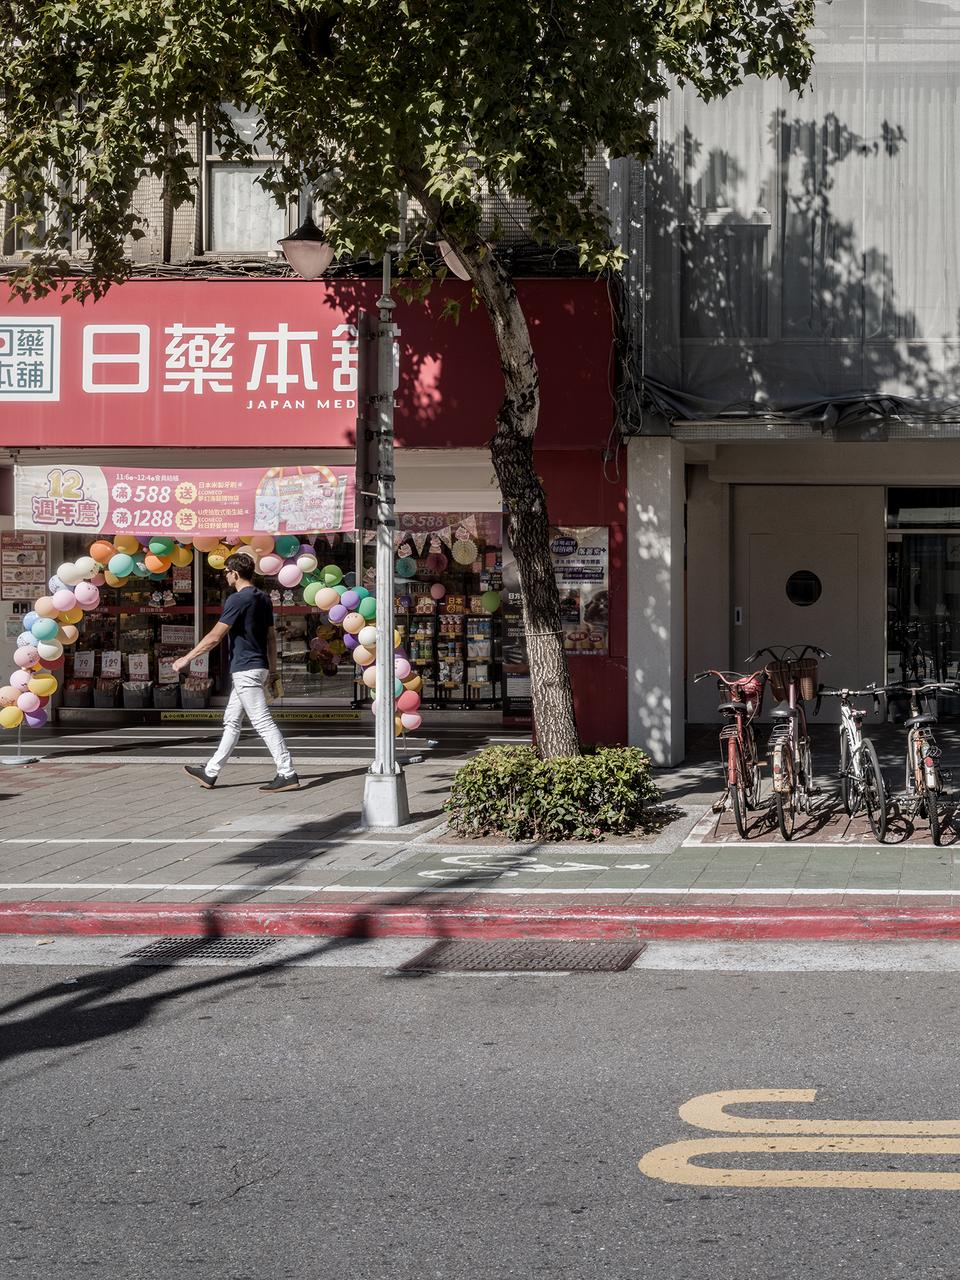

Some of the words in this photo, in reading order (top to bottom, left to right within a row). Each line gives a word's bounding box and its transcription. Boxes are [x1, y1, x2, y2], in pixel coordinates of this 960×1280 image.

[246, 400, 305, 409] JAPAN
[317, 400, 401, 409] MEDL
[48, 470, 83, 500] 12
[133, 486, 171, 503] 588
[33, 498, 101, 527] 週年慶
[133, 510, 173, 527] 1288
